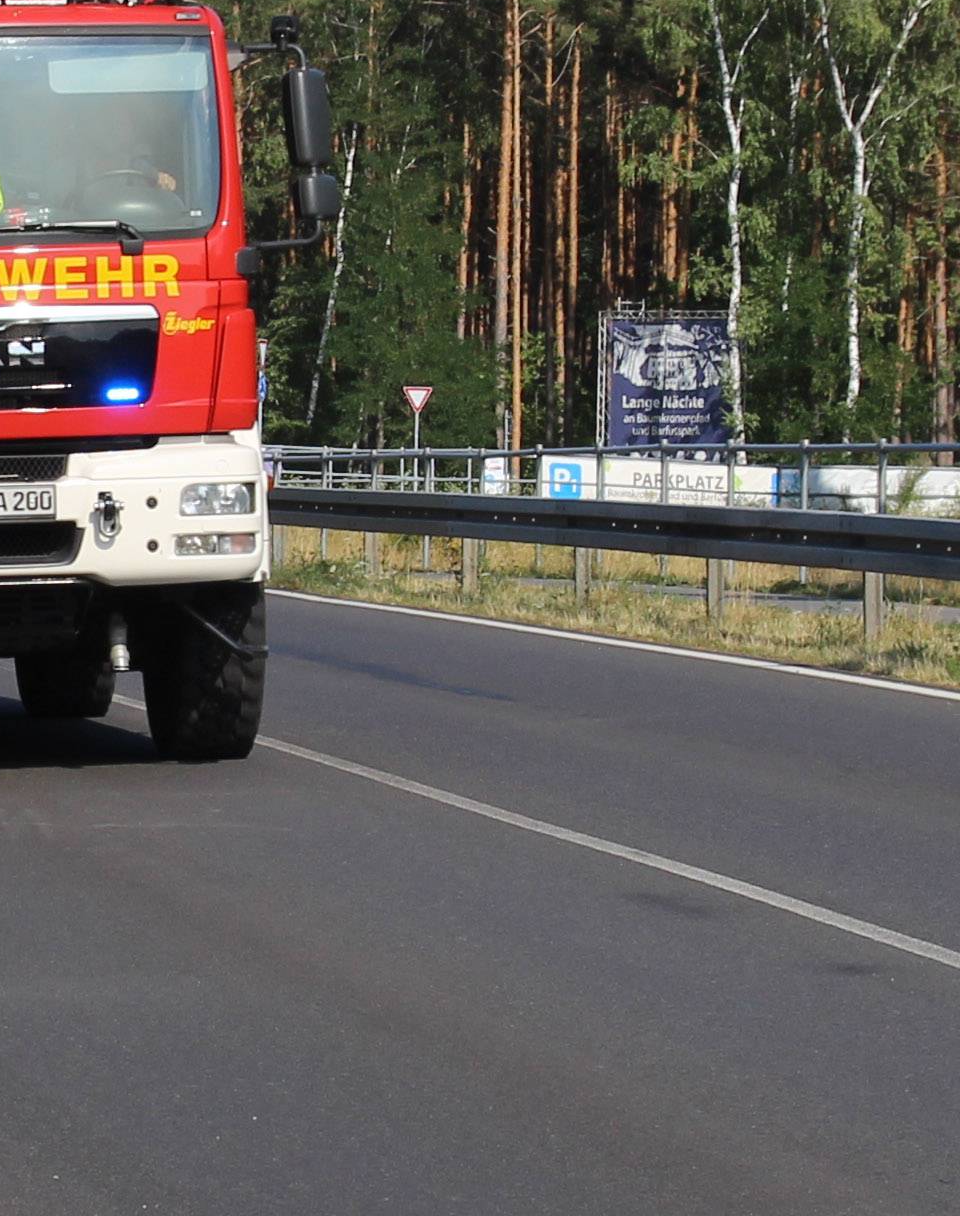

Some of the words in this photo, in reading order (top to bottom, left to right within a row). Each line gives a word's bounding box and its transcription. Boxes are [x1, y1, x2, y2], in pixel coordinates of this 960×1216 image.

[162, 310, 216, 335] Ziegler
[622, 395, 660, 411] Lange
[662, 395, 705, 409] Nächte
[623, 414, 636, 424] an
[13, 490, 52, 511] 200
